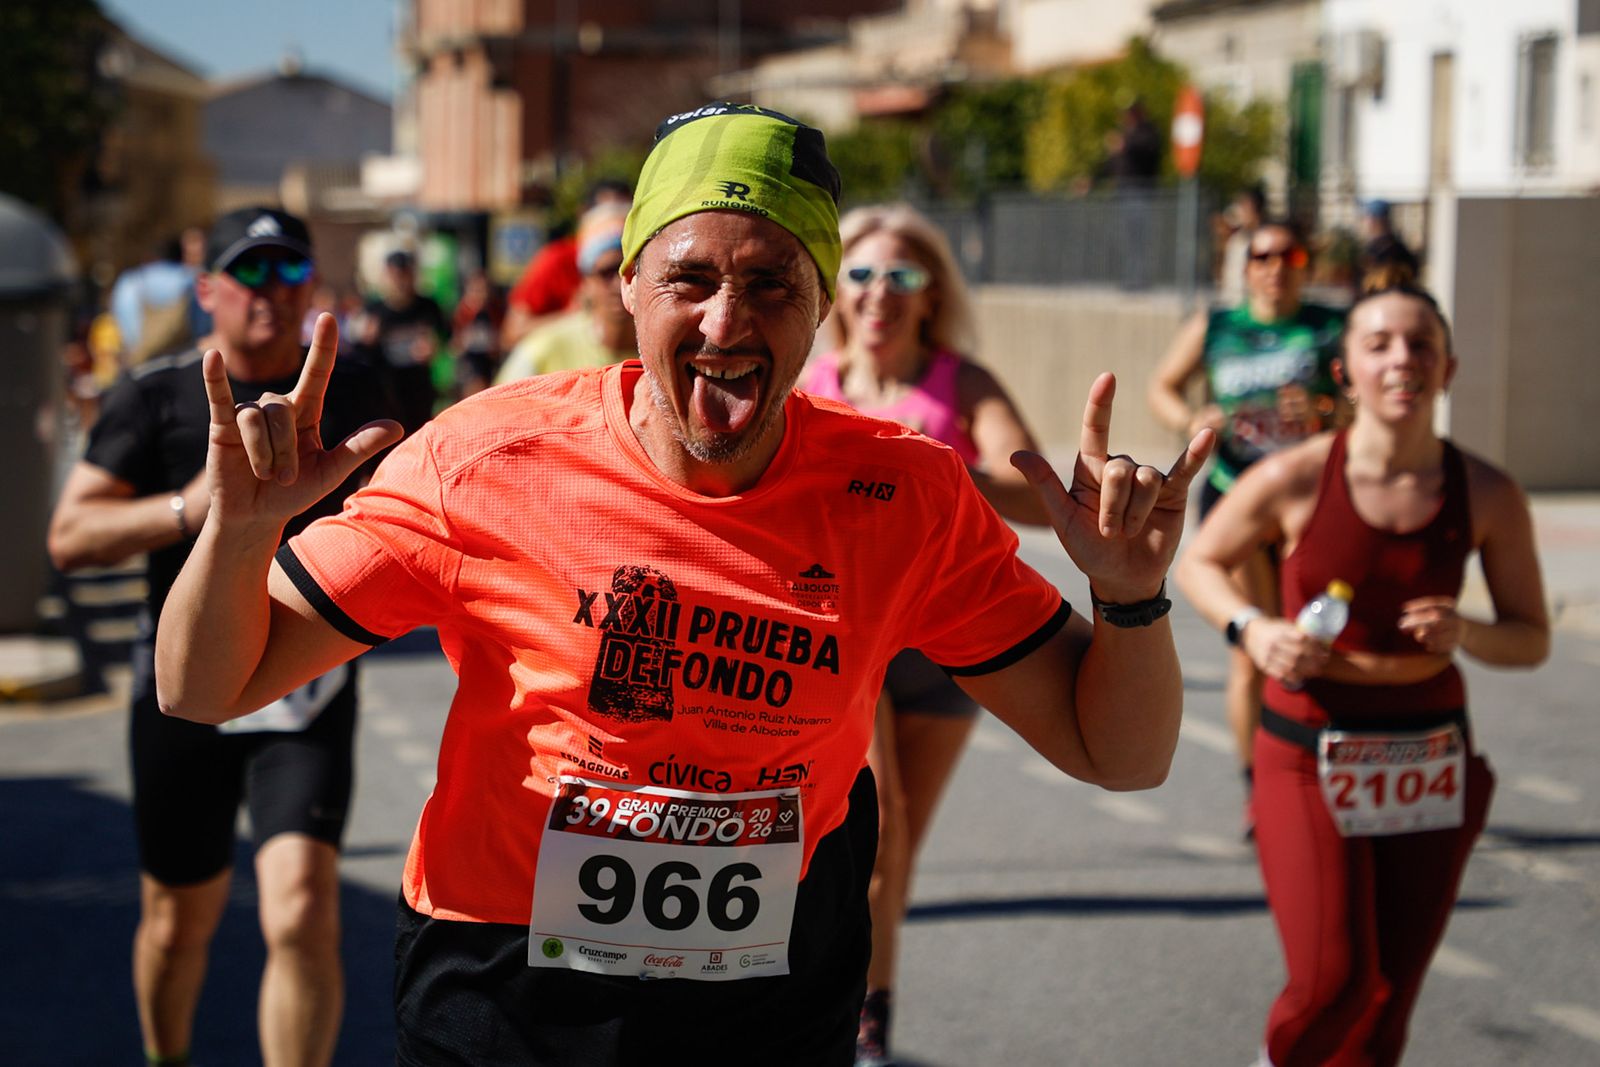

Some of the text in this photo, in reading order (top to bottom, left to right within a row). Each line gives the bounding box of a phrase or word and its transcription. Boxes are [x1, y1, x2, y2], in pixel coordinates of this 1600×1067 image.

[792, 583, 840, 593] ALBOLOTE
[573, 589, 840, 675] XXXII PRUEBA
[601, 639, 793, 708] DE FONDO
[677, 703, 832, 725] Juan Antonio Ruiz Navarro
[703, 718, 800, 738] Villa de Albolote
[1328, 764, 1457, 810] 2104
[566, 795, 744, 827] 39 GRAN PREMIO DE
[748, 808, 771, 824] 20
[607, 811, 745, 842] FONDO
[748, 822, 773, 838] 26
[577, 854, 762, 932] 966
[578, 945, 627, 961] Cruzcampo
